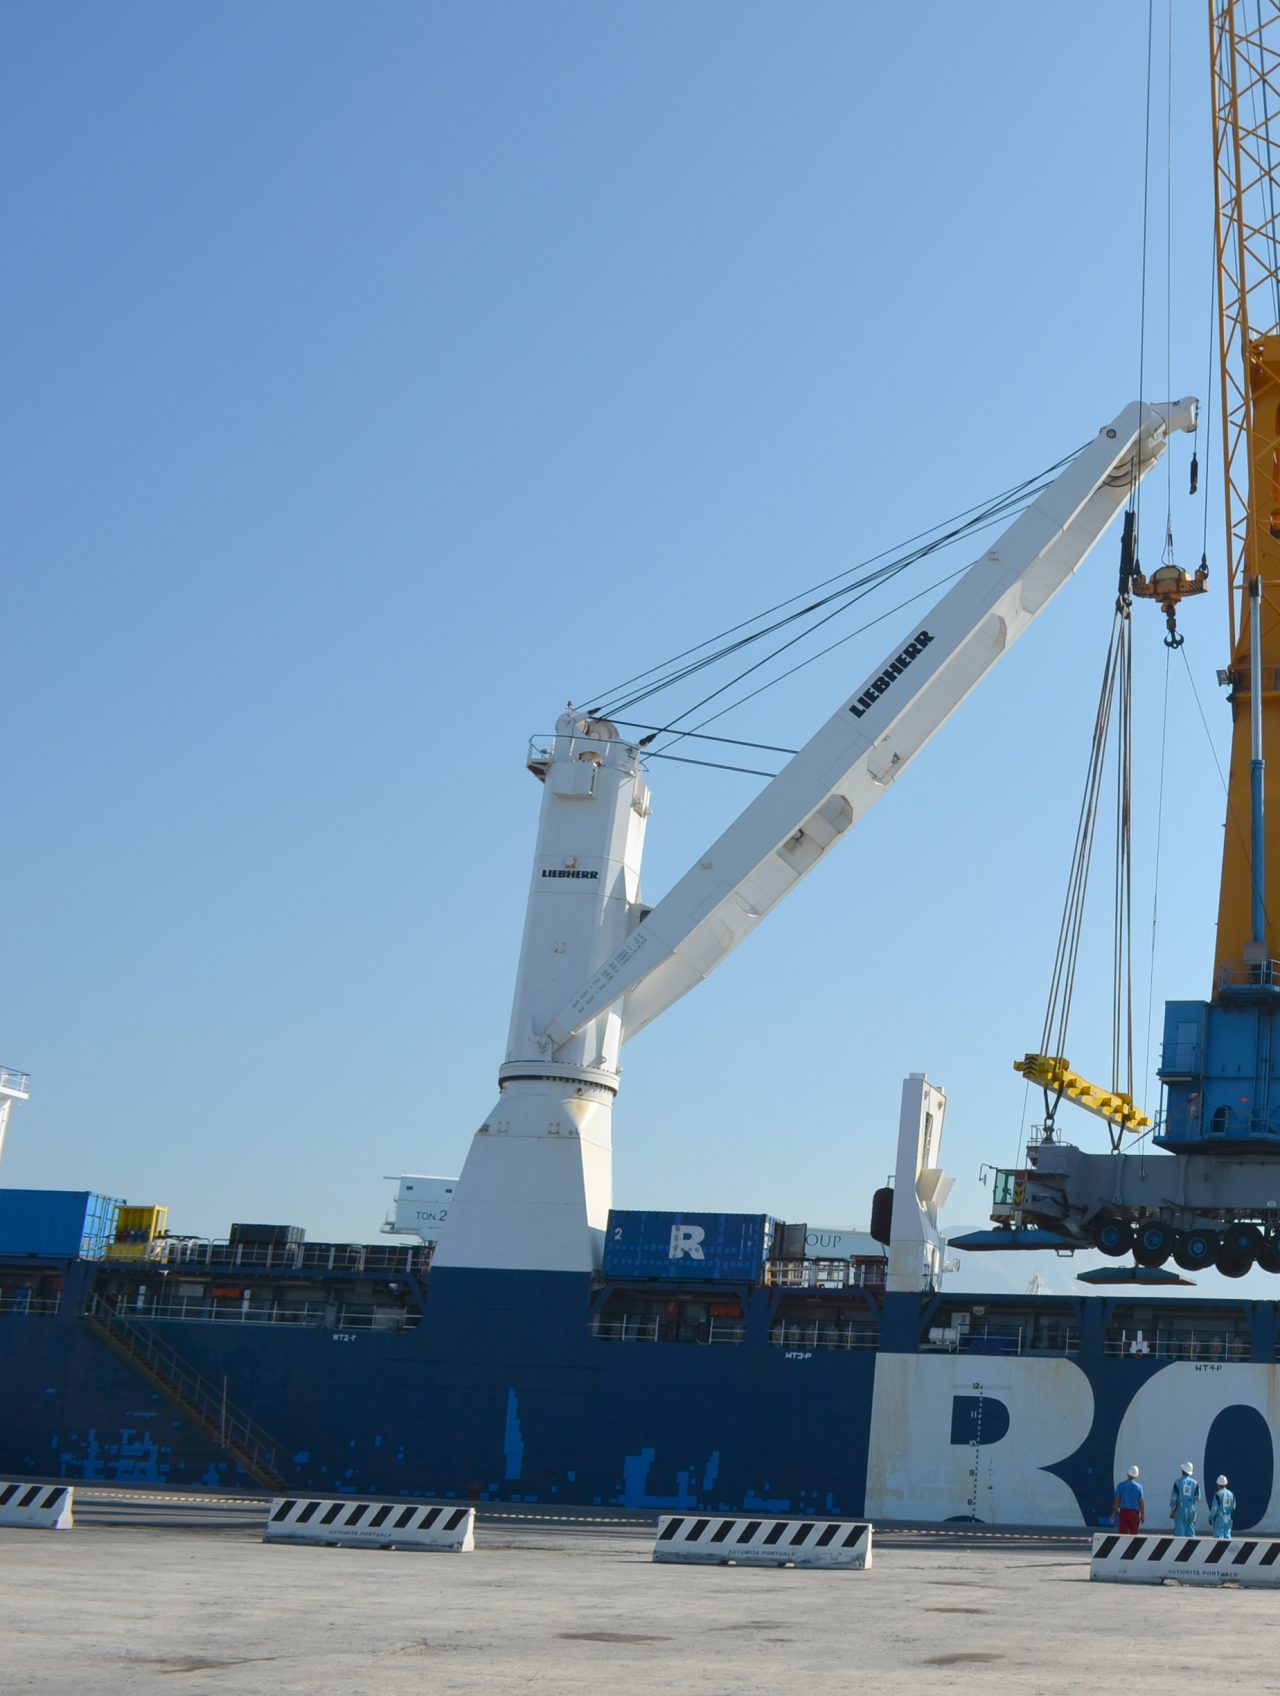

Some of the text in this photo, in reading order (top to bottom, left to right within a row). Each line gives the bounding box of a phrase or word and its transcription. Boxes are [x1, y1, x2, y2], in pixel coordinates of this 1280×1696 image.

[848, 630, 936, 719] LIEBHERR
[541, 869, 599, 880] LIEBHERR
[613, 1228, 623, 1240] 2
[668, 1224, 706, 1260] R
